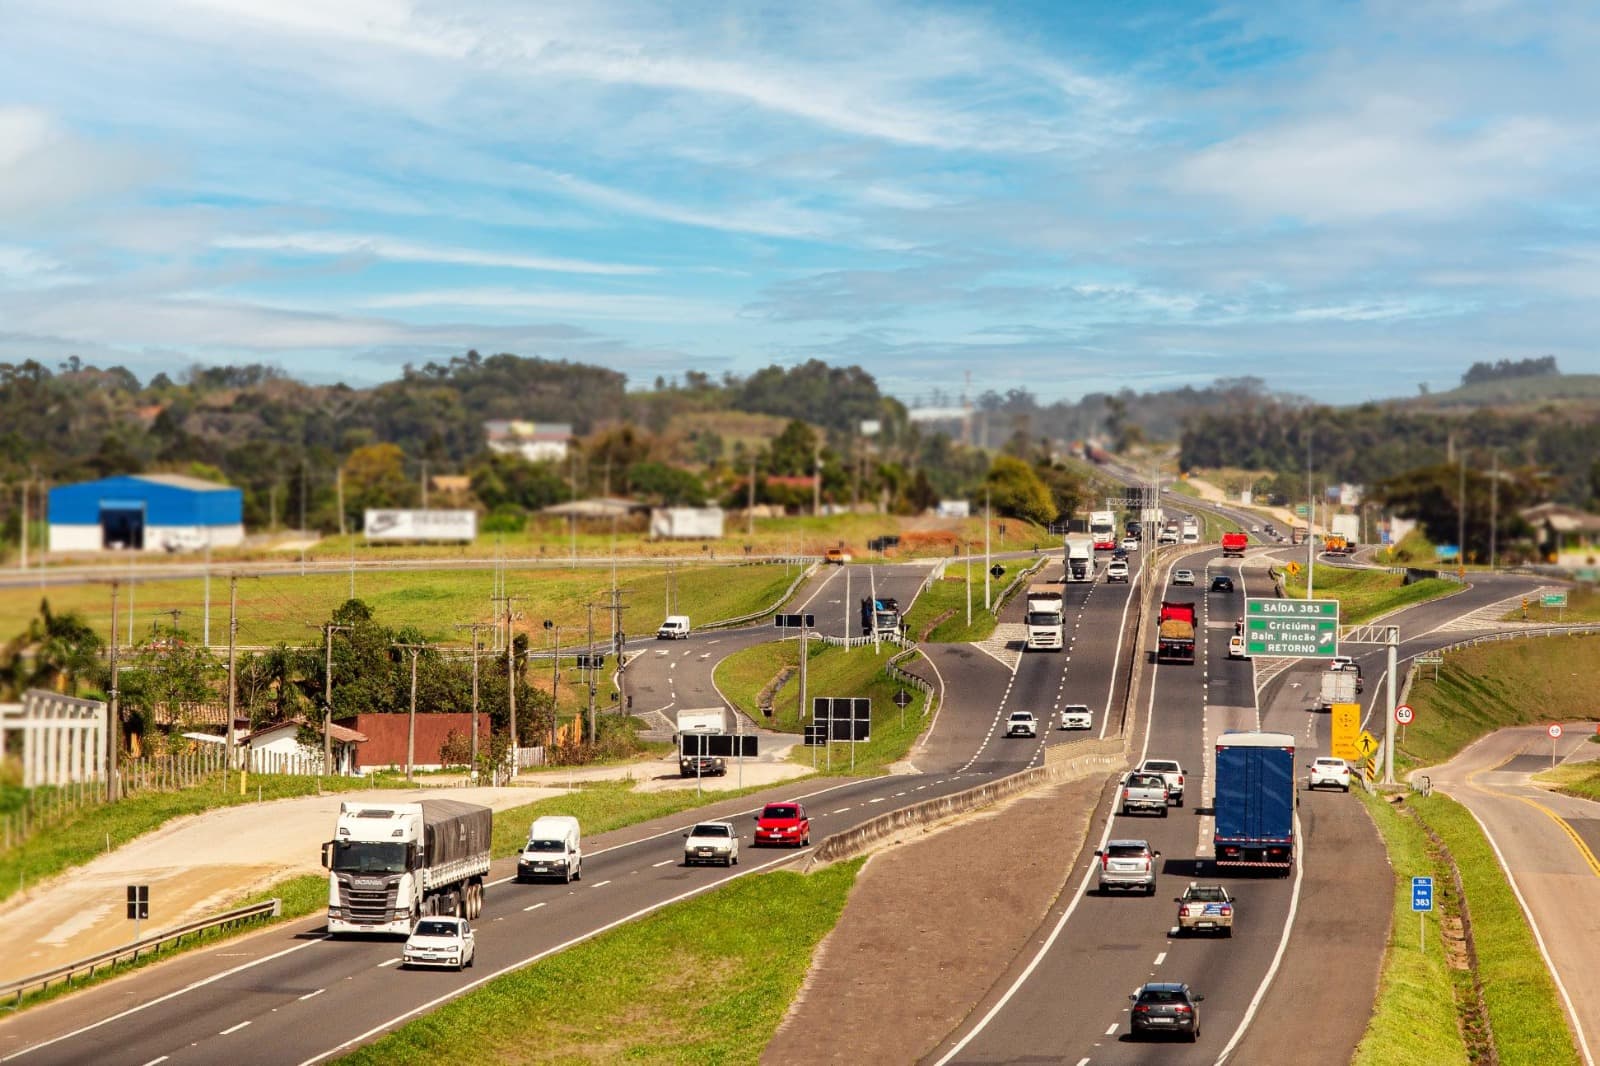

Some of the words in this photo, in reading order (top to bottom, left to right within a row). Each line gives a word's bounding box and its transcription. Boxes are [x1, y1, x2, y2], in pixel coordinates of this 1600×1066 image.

[1263, 602, 1295, 613] SAÍDA
[1300, 605, 1320, 613] 383
[1269, 621, 1316, 631] Criciúma
[1251, 631, 1276, 641] Baln.
[1281, 632, 1316, 642] Rincão
[1268, 643, 1316, 653] RETORNO
